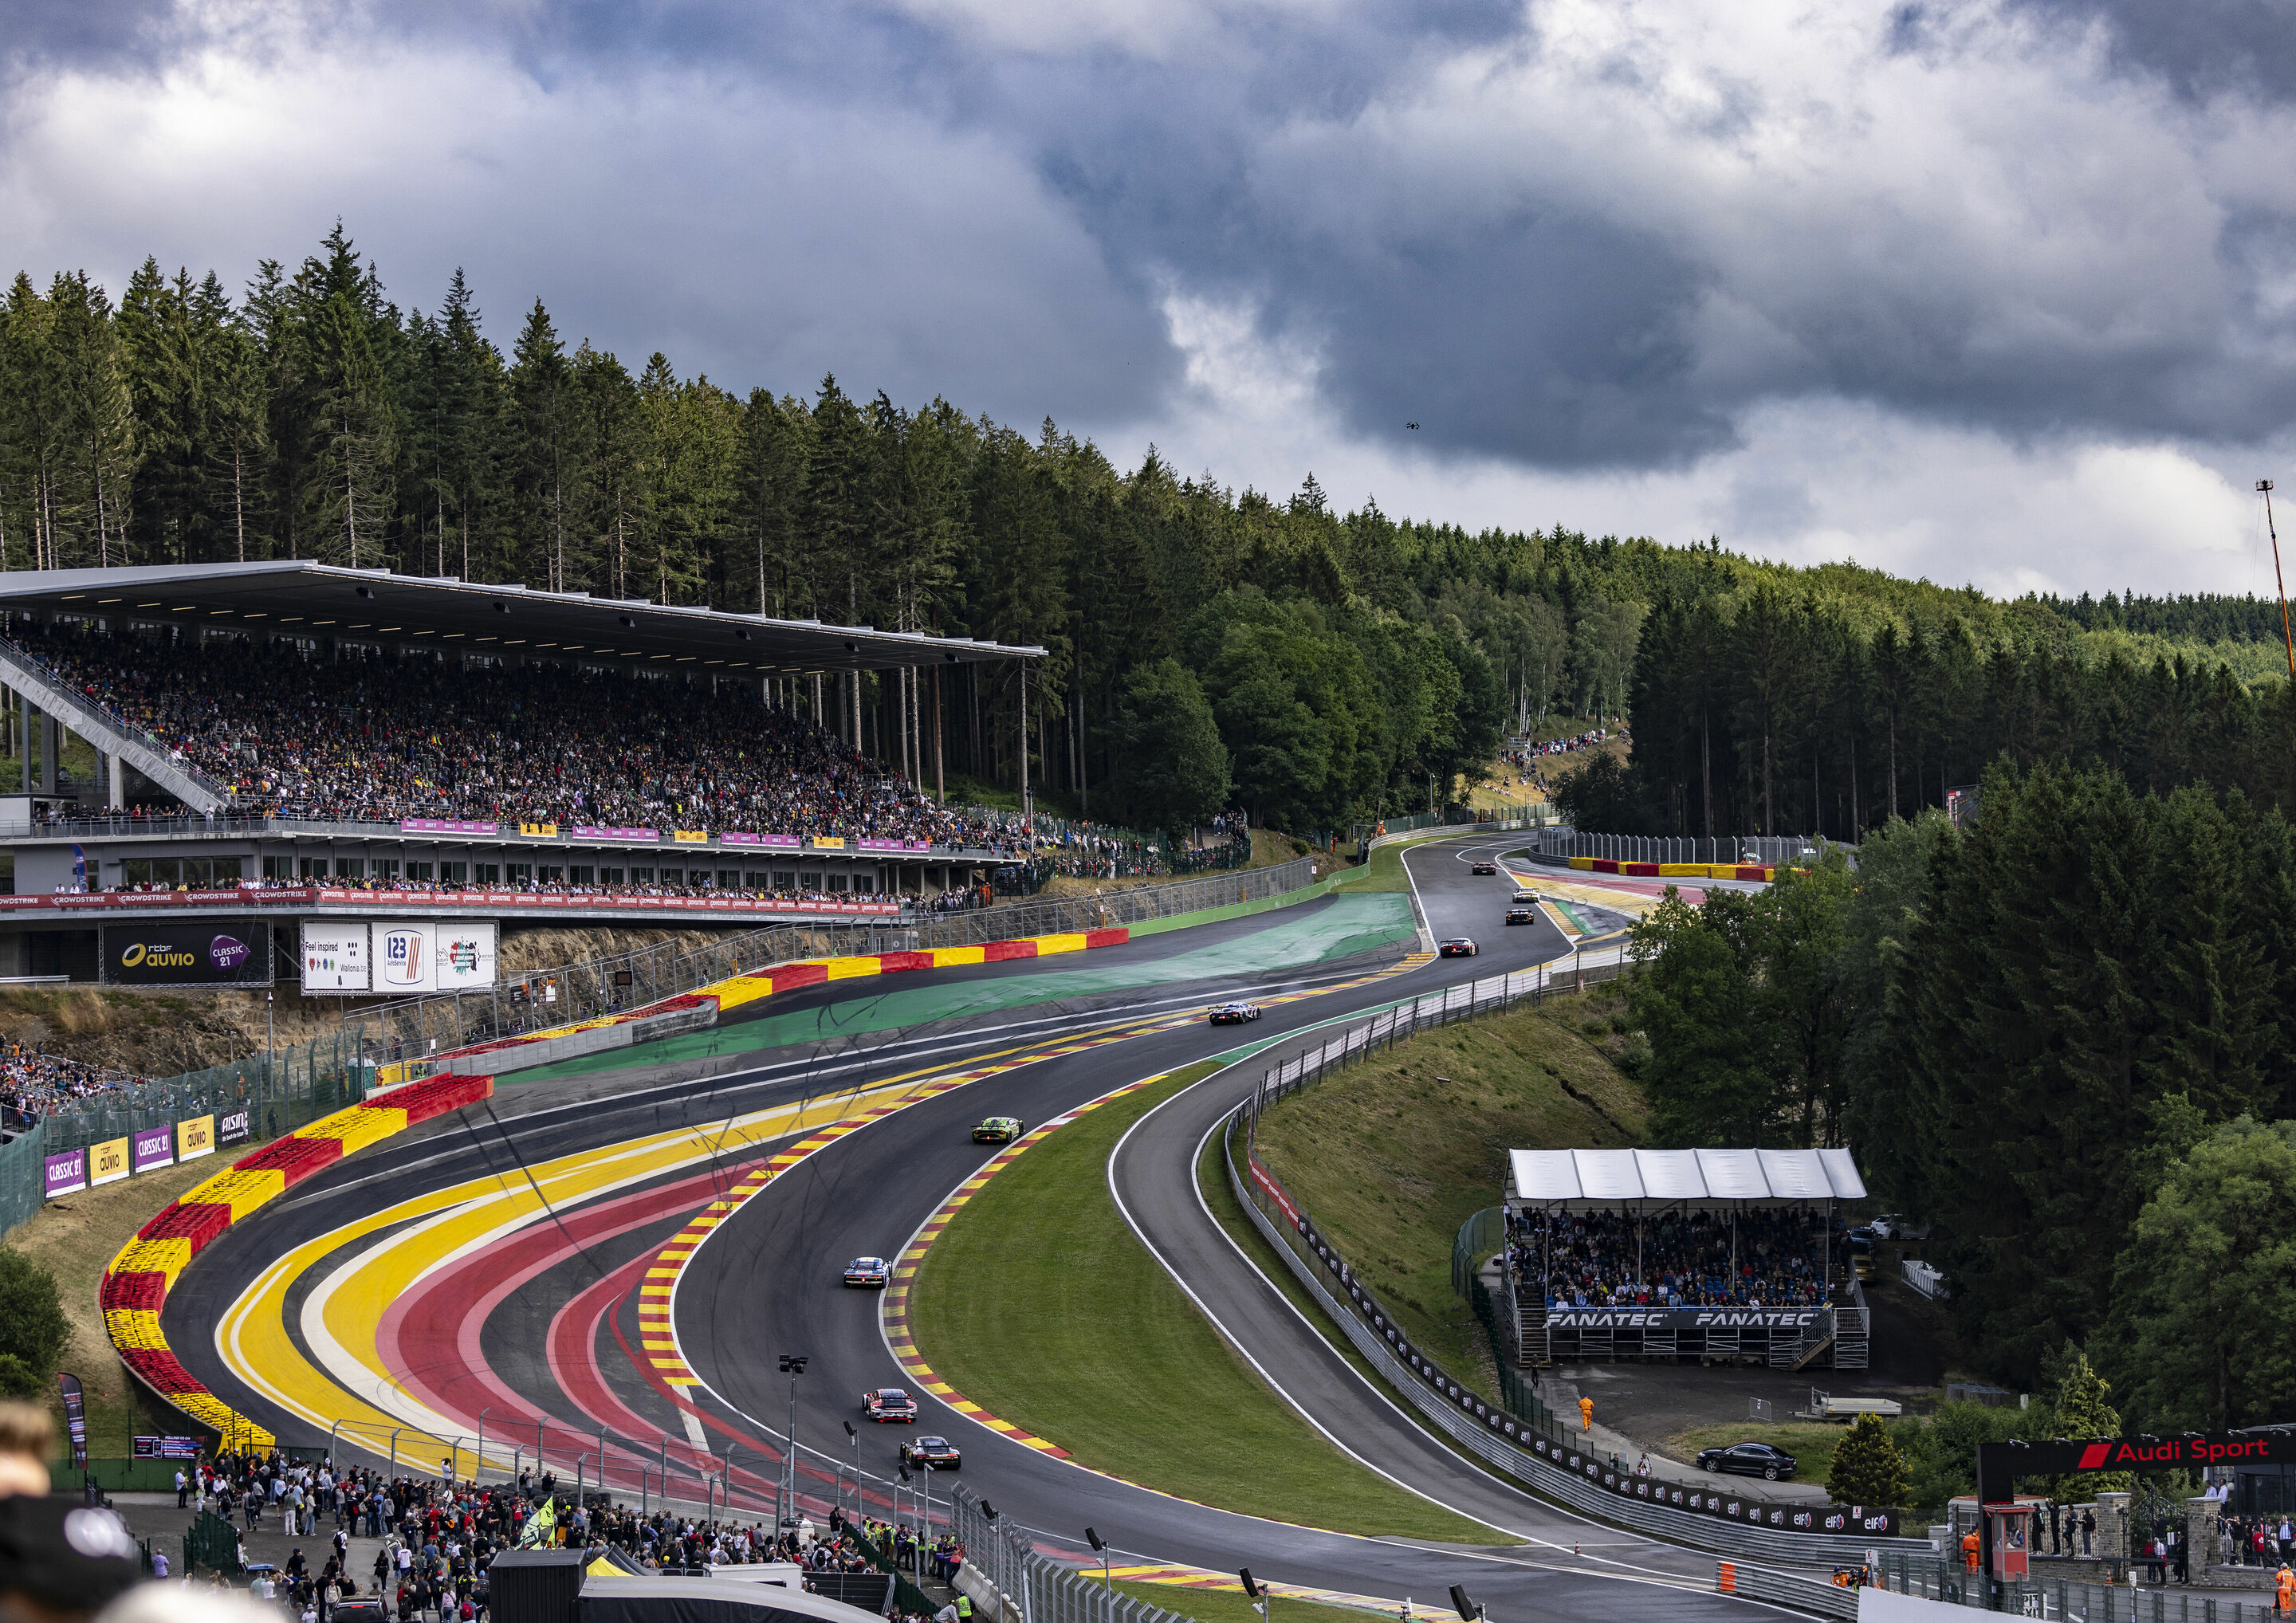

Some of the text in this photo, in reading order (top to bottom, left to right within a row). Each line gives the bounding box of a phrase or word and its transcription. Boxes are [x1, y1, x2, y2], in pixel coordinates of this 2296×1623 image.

[212, 945, 244, 957] CLASSIC
[305, 942, 338, 953] Feel inspired
[387, 937, 407, 958] 123
[147, 953, 195, 966] auvio
[220, 957, 230, 967] 21
[340, 964, 367, 973] Wallonia.be
[222, 1113, 244, 1134] AISIN
[139, 1134, 169, 1157] CLASSIC 21
[187, 1130, 206, 1148] auvio
[100, 1154, 120, 1172] auvio
[49, 1158, 81, 1182] CLASSIC 21
[1547, 1314, 1665, 1326] FANATEC
[1696, 1313, 1814, 1326] FANATEC
[2116, 1439, 2269, 1463] Audi Sport
[1794, 1514, 1805, 1526] elf
[1826, 1516, 1837, 1528] elf
[1864, 1516, 1878, 1530] elf
